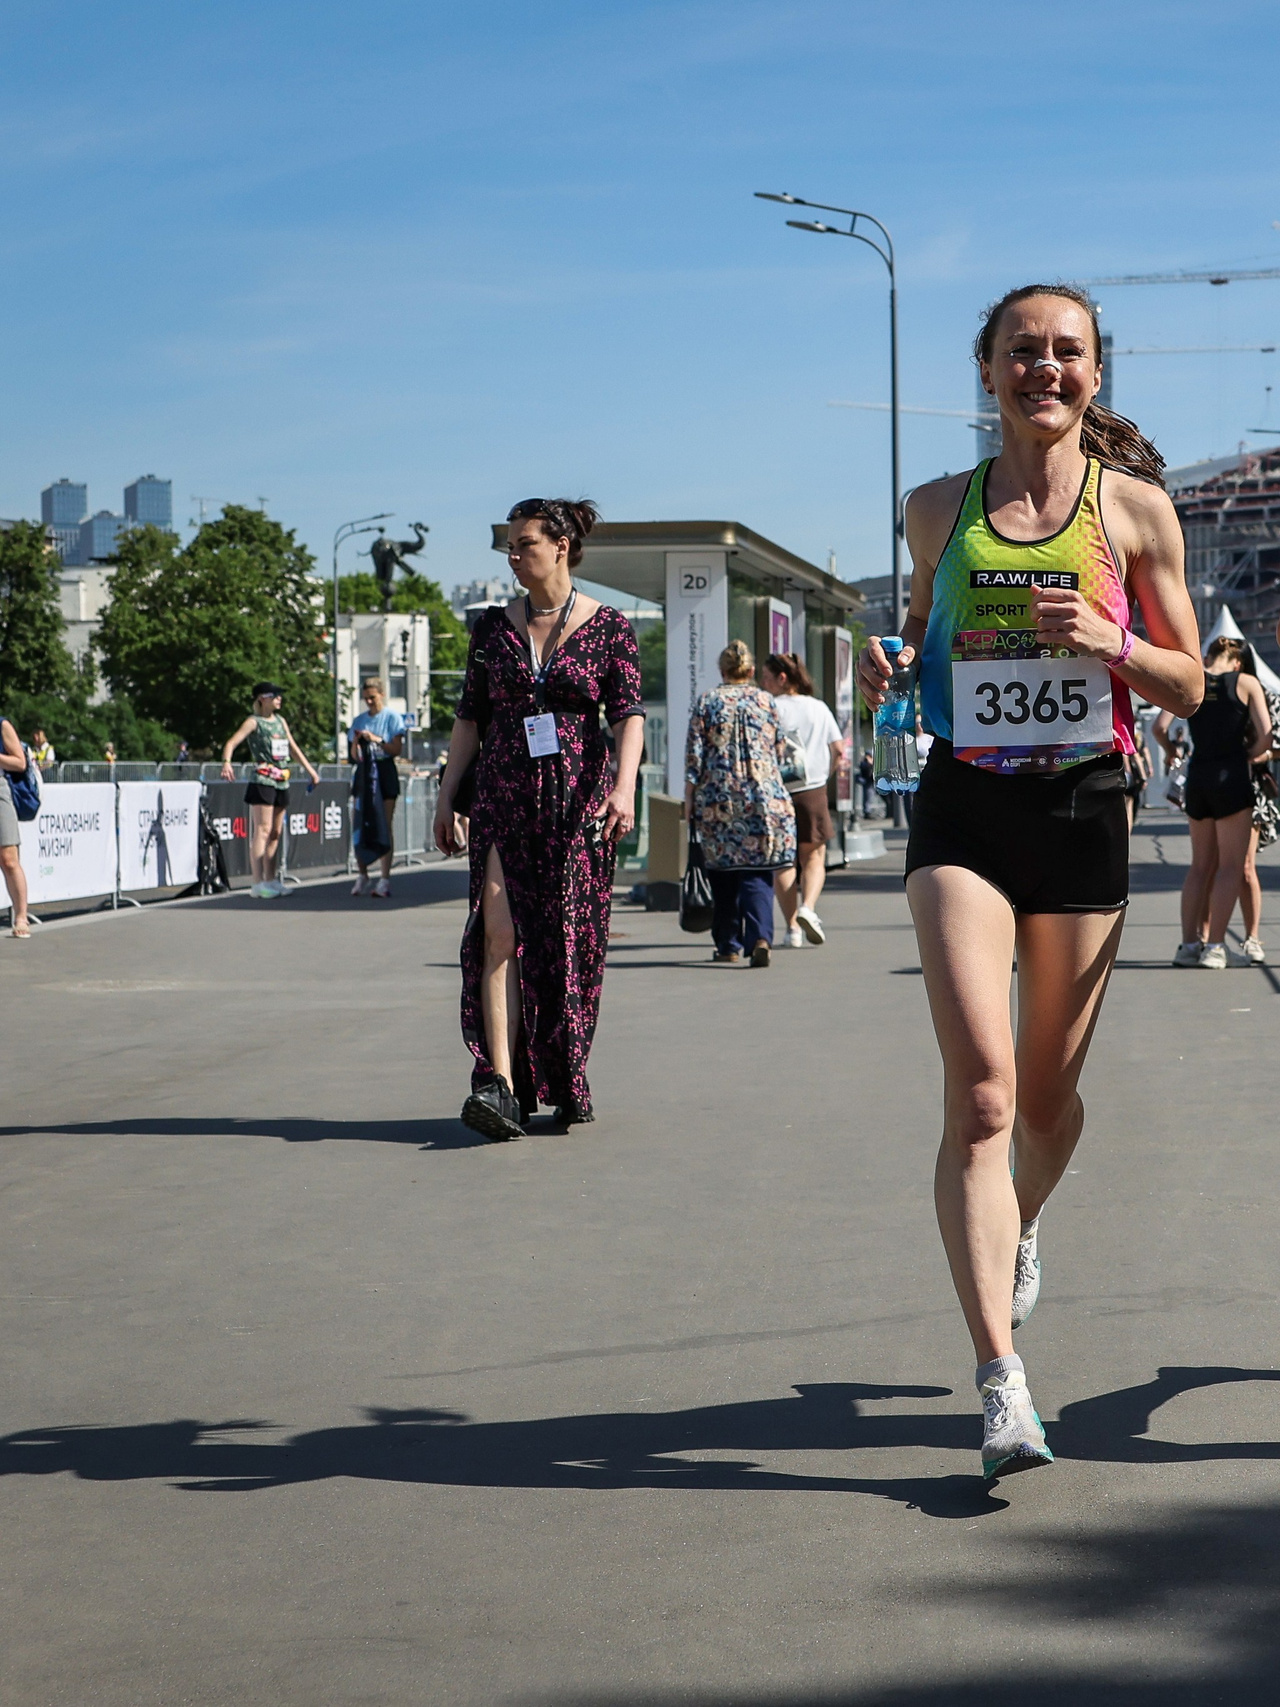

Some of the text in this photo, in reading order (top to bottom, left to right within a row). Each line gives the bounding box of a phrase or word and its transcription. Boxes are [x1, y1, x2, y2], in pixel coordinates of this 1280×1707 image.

[683, 574, 707, 590] 2D
[975, 603, 1027, 617] SPORT
[974, 679, 1089, 725] 3365
[38, 811, 100, 834] СТРАХОВАНИЕ
[38, 838, 73, 857] ЖИЗНИ
